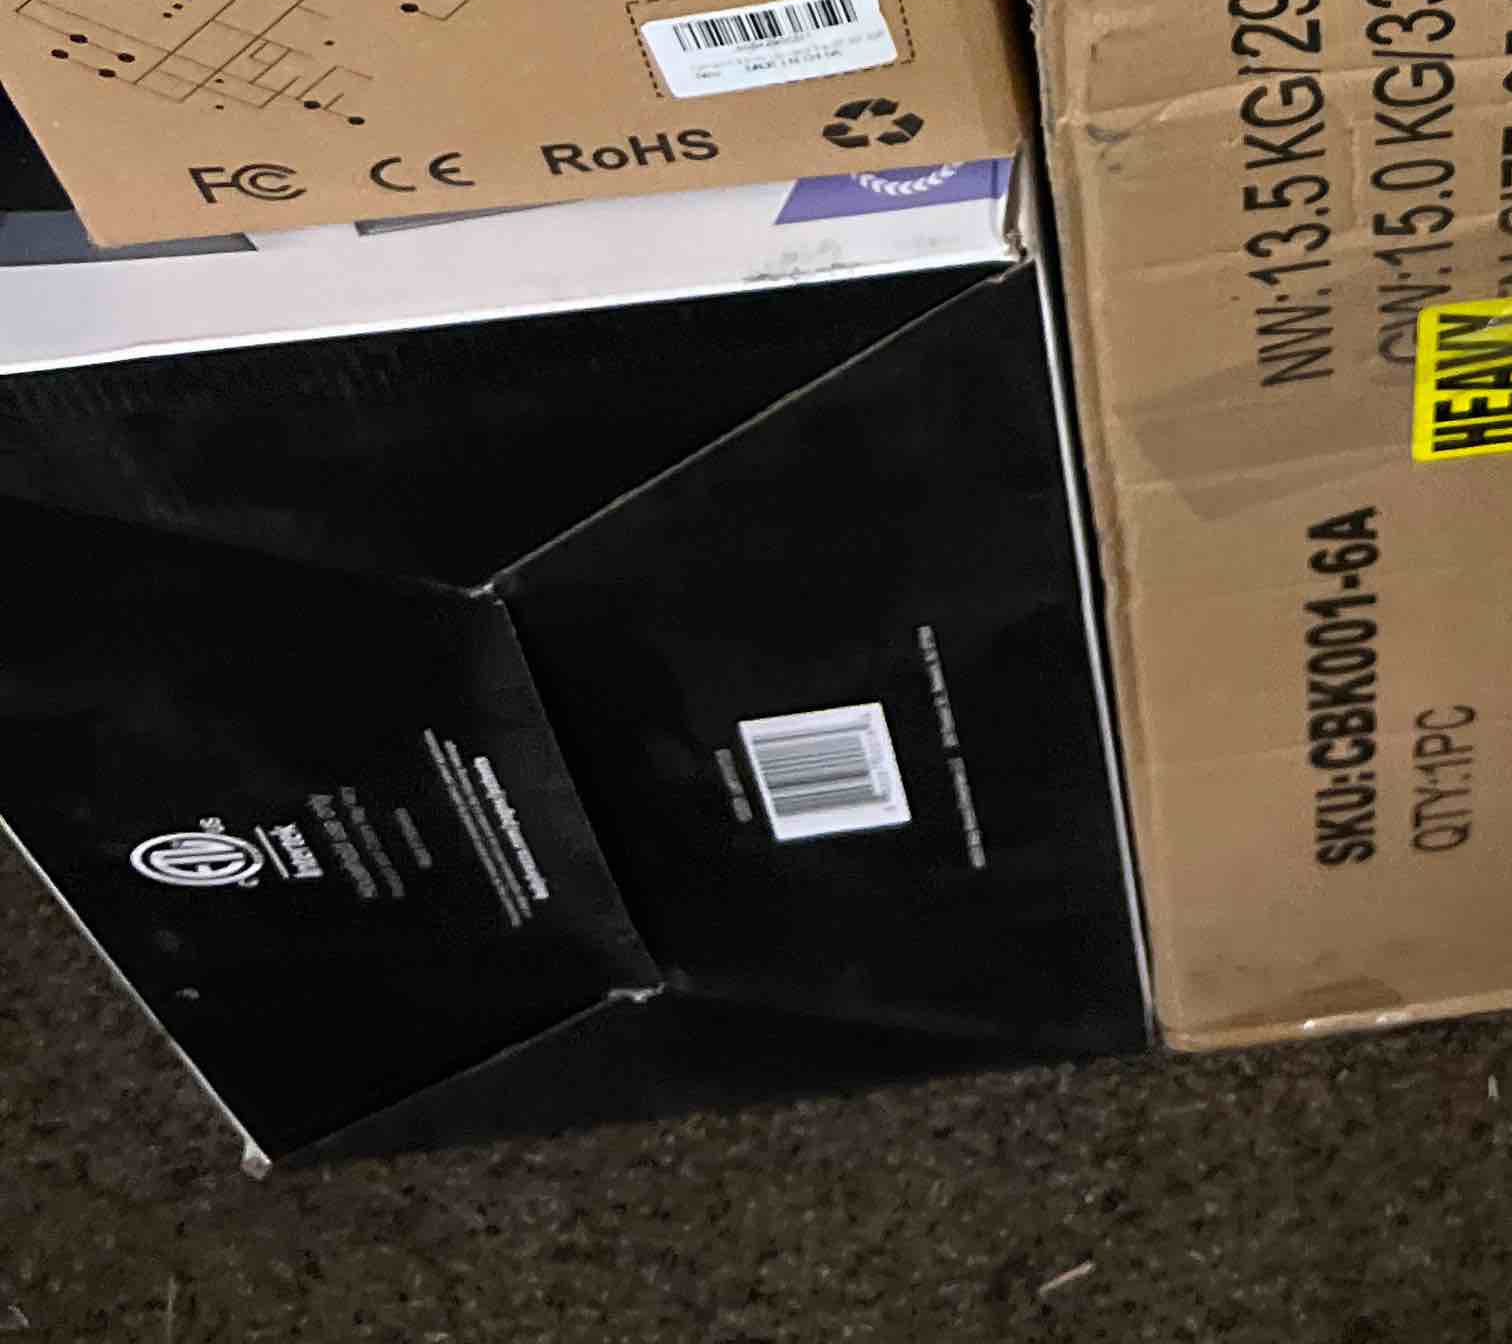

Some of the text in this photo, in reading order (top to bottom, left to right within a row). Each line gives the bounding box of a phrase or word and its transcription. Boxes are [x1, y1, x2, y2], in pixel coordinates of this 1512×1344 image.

[370, 150, 476, 193] CE
[540, 127, 722, 178] RoHS
[1411, 703, 1478, 854] QTY:1PC
